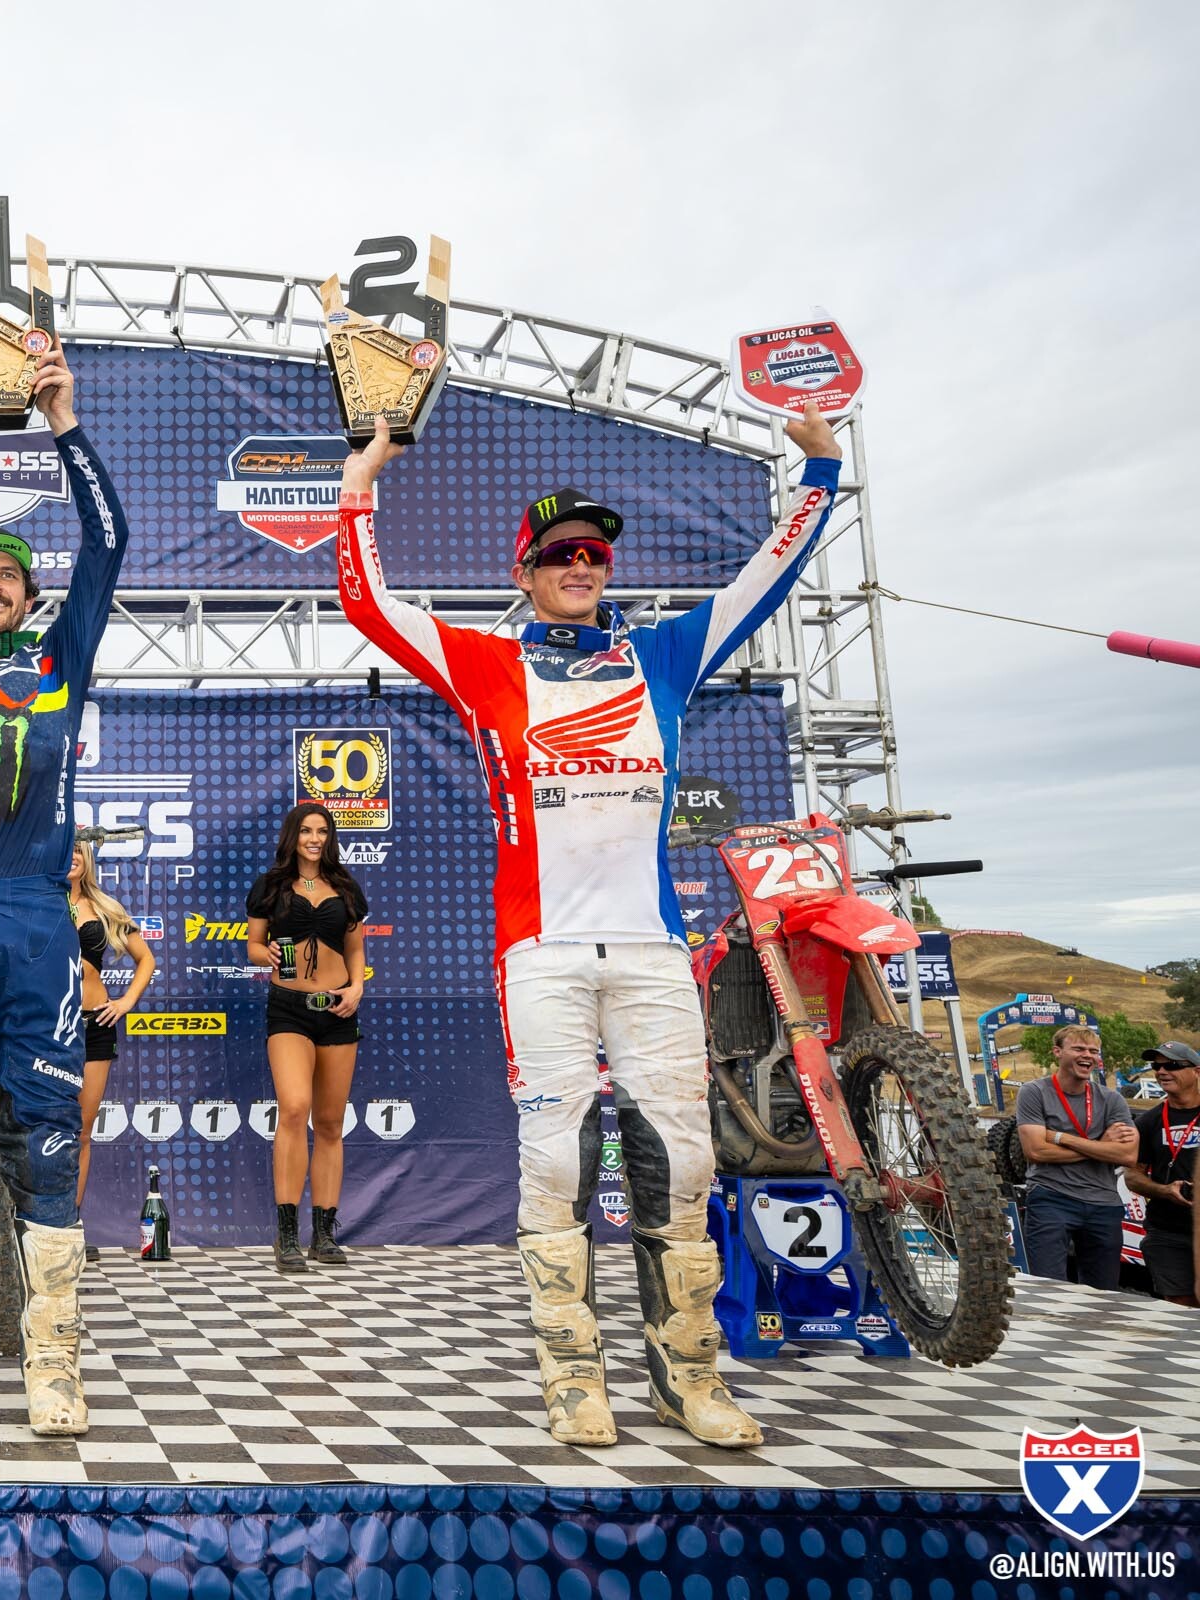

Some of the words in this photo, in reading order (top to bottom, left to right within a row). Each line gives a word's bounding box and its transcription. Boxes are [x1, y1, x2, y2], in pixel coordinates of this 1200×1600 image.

[767, 330, 797, 342] LUCAS
[799, 327, 814, 336] OIL
[776, 349, 805, 361] LUCAS
[807, 347, 821, 355] OIL
[771, 360, 837, 377] MOTOCROSS
[827, 393, 851, 401] LEADER
[238, 452, 308, 473] CCM
[247, 514, 307, 522] MOTOCROSS
[309, 740, 380, 793] 50
[528, 757, 666, 778] HONDA
[581, 791, 629, 799] DUNLOP
[323, 800, 350, 808] LUCAS
[351, 800, 364, 808] OIL
[355, 854, 379, 862] PLUS
[748, 843, 842, 899] 23
[800, 1073, 837, 1156] DUNLOP
[605, 1150, 617, 1165] 2
[783, 1206, 828, 1257] 2
[760, 1315, 780, 1329] 50
